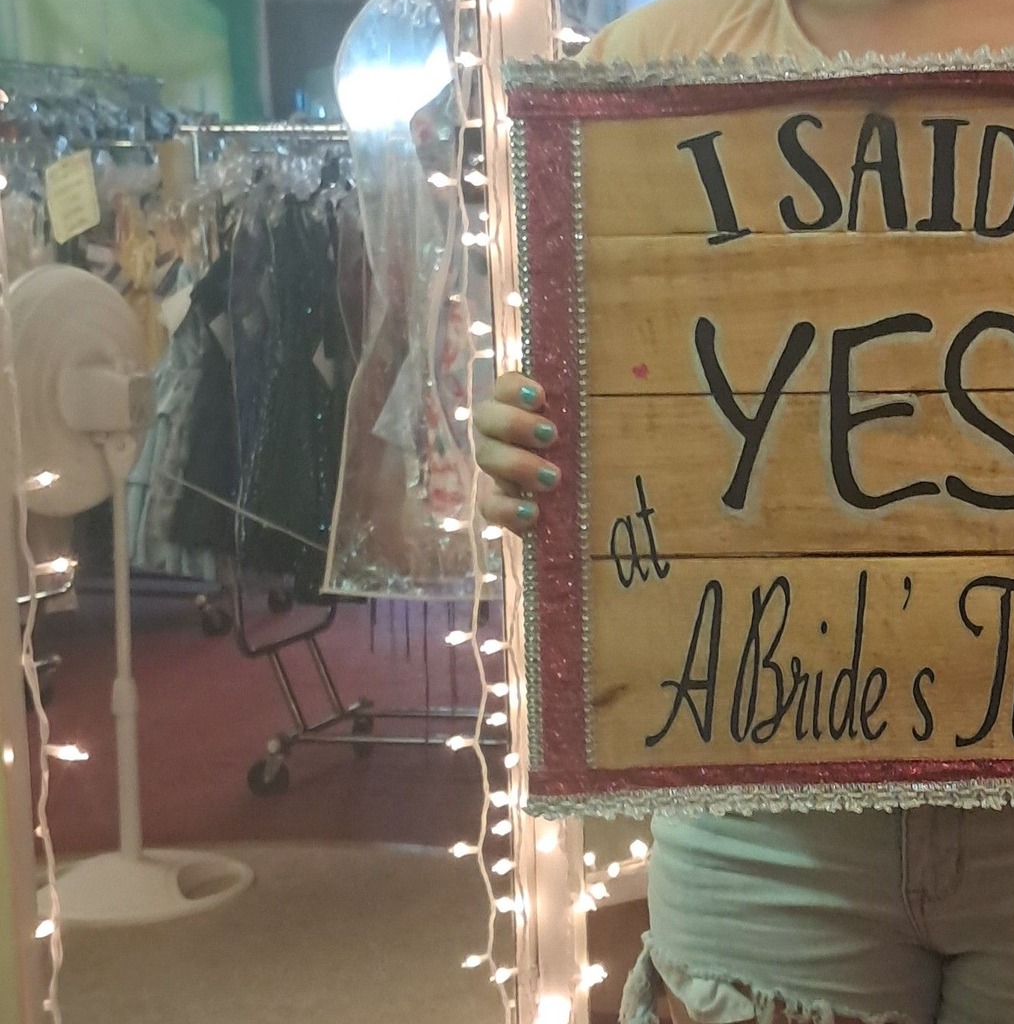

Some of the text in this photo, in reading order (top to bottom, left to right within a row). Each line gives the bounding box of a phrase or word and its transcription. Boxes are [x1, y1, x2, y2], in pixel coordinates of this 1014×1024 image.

[676, 129, 753, 245] I
[608, 474, 672, 589] at
[645, 579, 725, 748] A
[729, 570, 937, 744] Bride's
